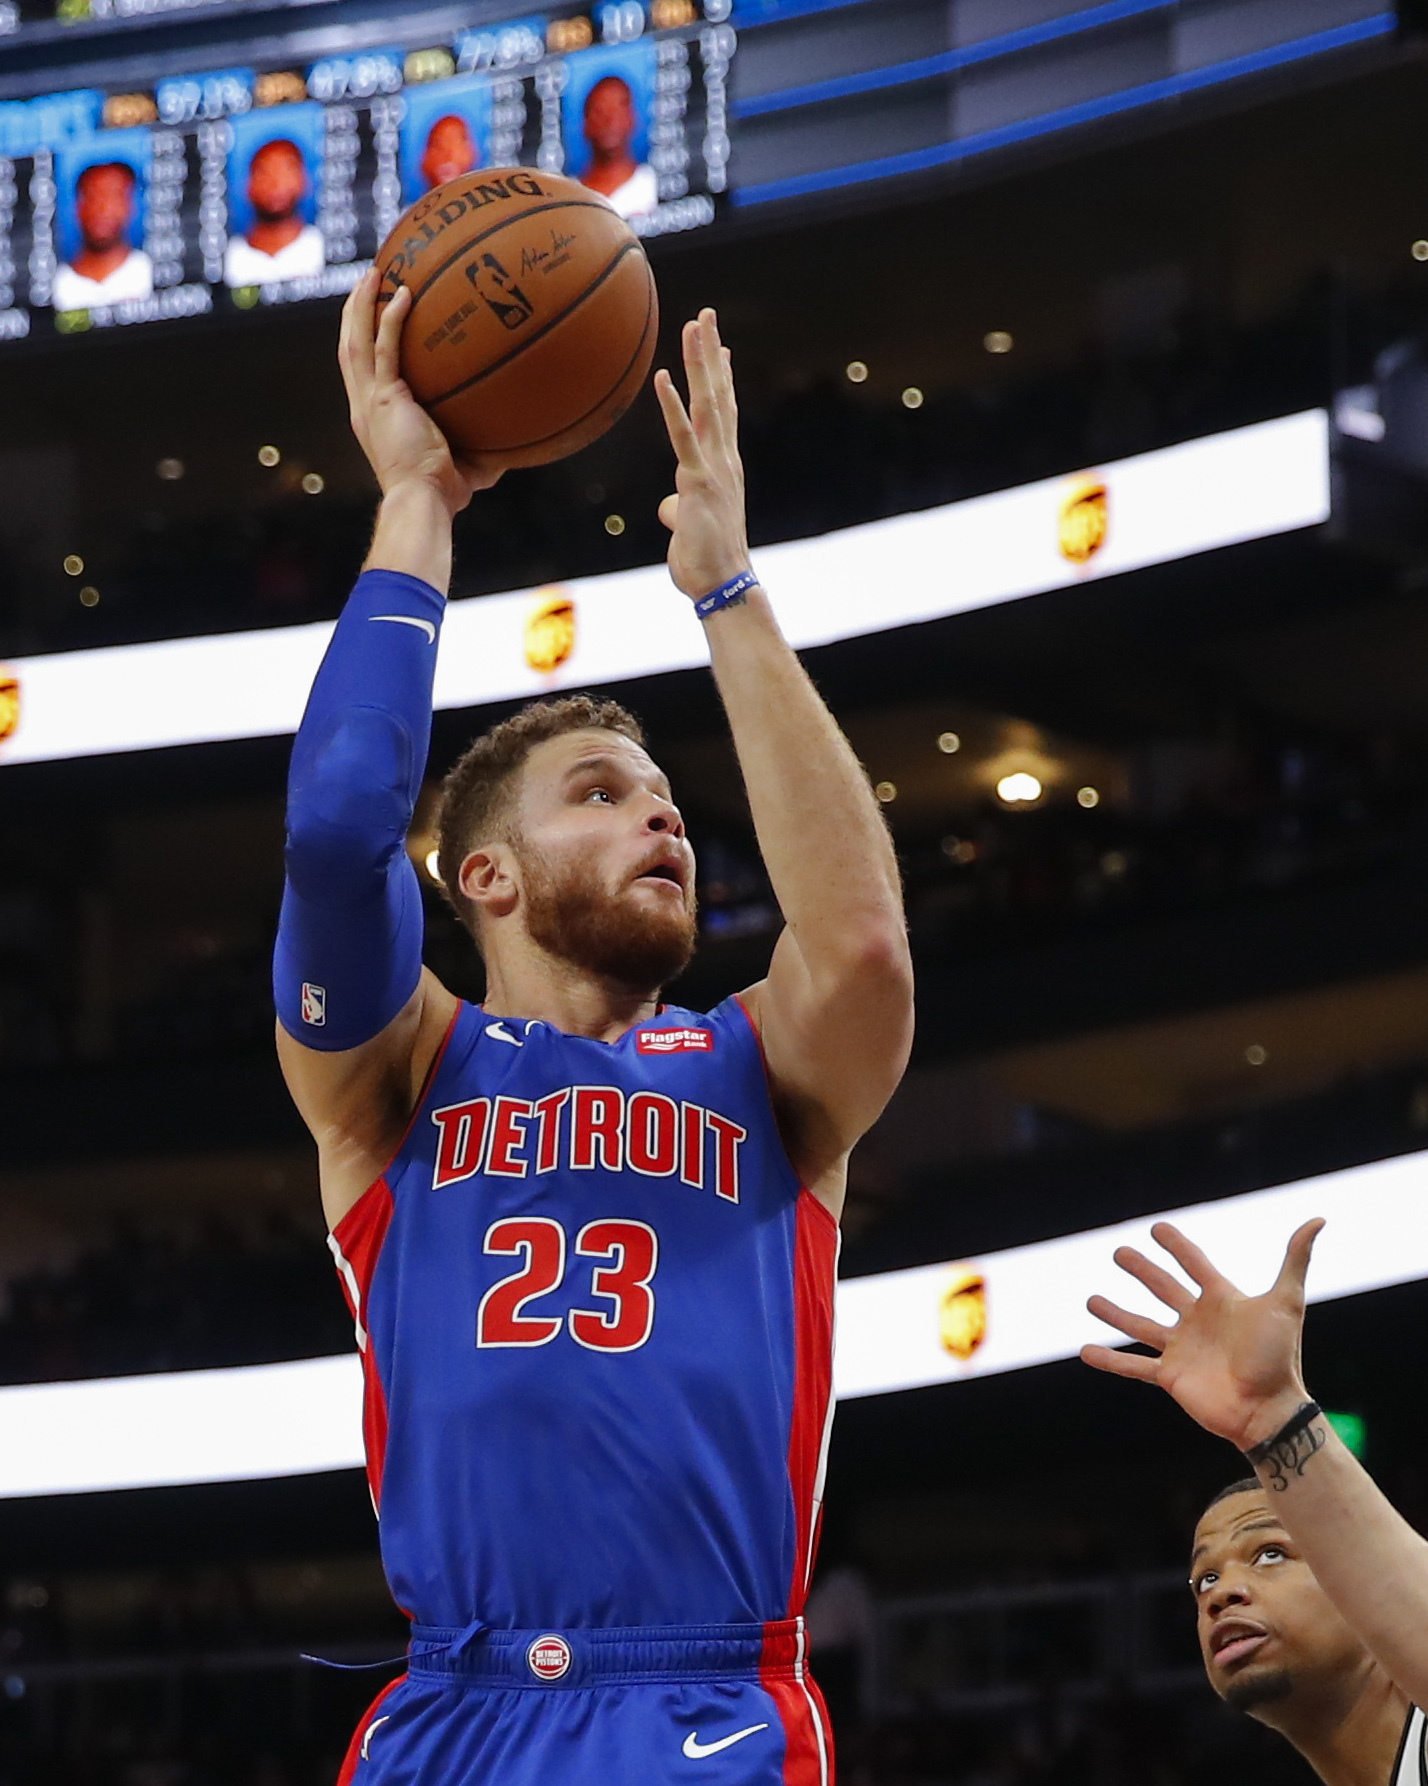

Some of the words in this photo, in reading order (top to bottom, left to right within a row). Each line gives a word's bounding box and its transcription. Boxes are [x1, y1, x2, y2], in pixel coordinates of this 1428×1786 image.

[377, 173, 544, 302] PALDING
[641, 1030, 707, 1044] Flagstar
[431, 1085, 747, 1205] DETROIT
[476, 1216, 659, 1354] 23
